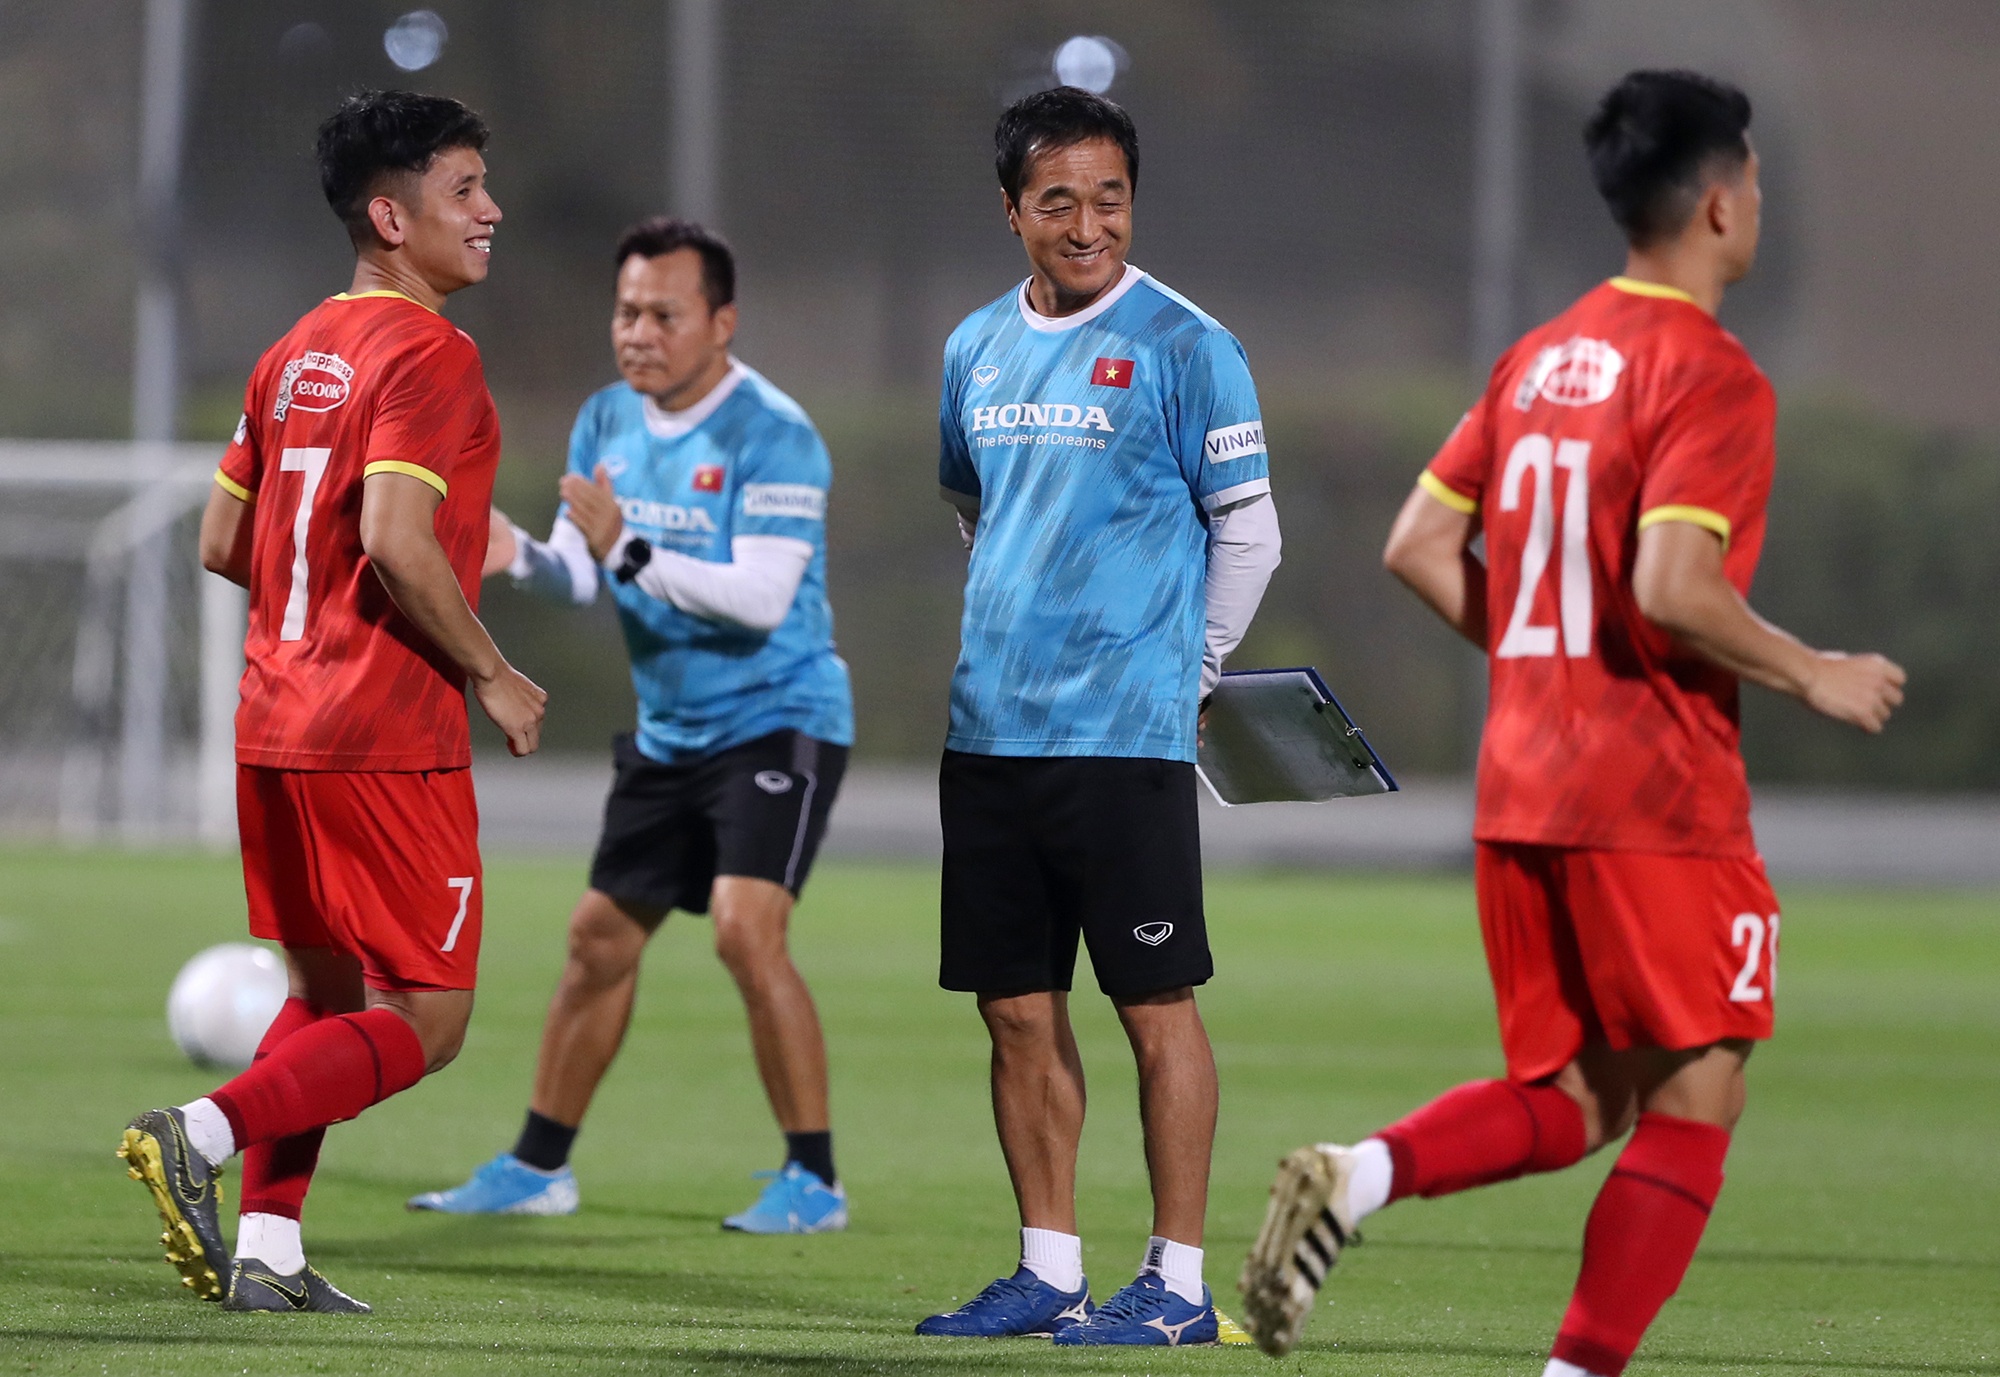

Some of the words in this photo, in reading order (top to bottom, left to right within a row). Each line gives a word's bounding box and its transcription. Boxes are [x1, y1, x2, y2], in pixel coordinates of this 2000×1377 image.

[972, 403, 1115, 432] HONDA
[976, 436, 996, 448] The
[1036, 432, 1049, 445] of
[1051, 432, 1106, 449] Dreams
[613, 497, 720, 532] ONDA
[279, 447, 332, 642] 7
[1496, 433, 1592, 659] 21
[440, 876, 474, 952] 7
